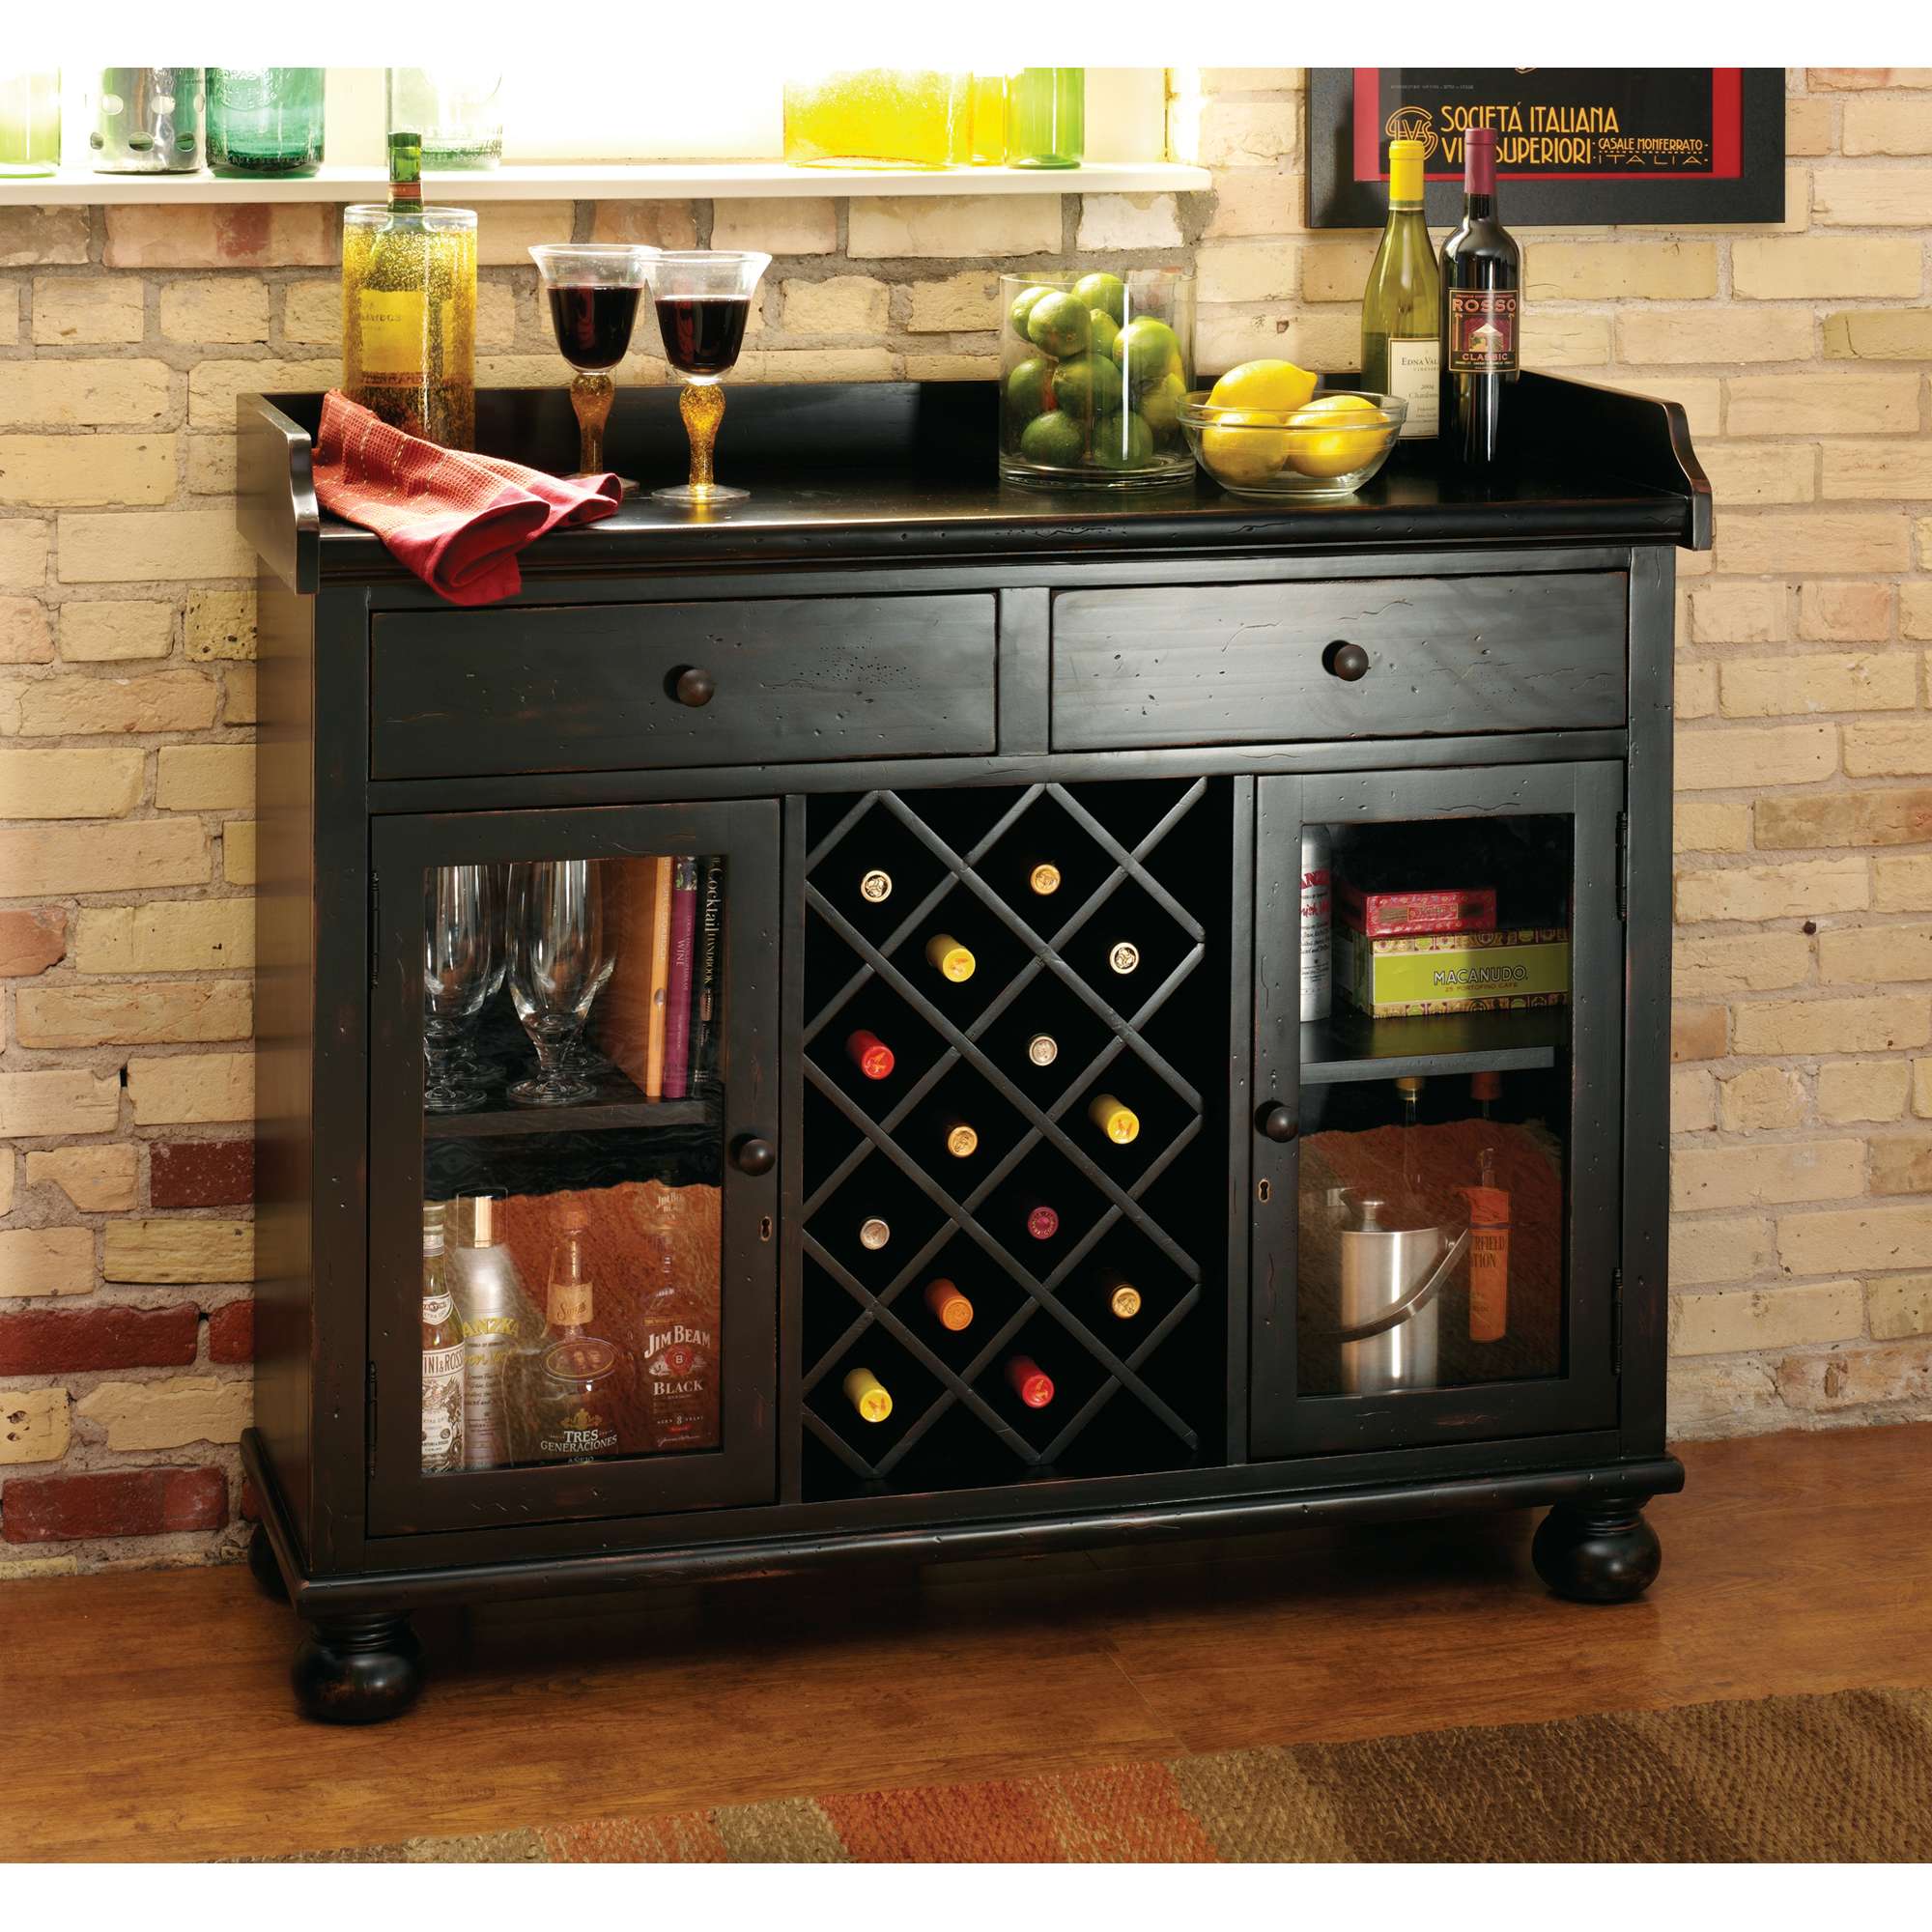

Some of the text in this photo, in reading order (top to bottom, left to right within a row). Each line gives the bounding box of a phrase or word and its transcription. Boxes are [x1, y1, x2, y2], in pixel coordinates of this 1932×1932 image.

[1530, 106, 1619, 132] ITALIANA
[1441, 137, 1463, 162] VI
[1599, 138, 1703, 151] CASALE MONFERRATO
[1599, 155, 1702, 165] ITALIA
[1452, 298, 1517, 313] ROSSO
[1425, 356, 1439, 365] VAL
[1462, 353, 1508, 361] CLASSIC
[704, 867, 724, 931] Cocktail
[676, 940, 685, 966] WINE
[1434, 965, 1526, 985] MACANUDO
[1475, 1236, 1507, 1252] RFIELD
[1473, 1253, 1496, 1267] TION
[463, 1318, 519, 1338] ANZKA
[644, 1324, 711, 1359] JIM BEAM
[675, 1354, 684, 1364] B
[653, 1379, 703, 1396] BLACK
[540, 1435, 618, 1453] GENERACIONES
[564, 1429, 599, 1443] TRES
